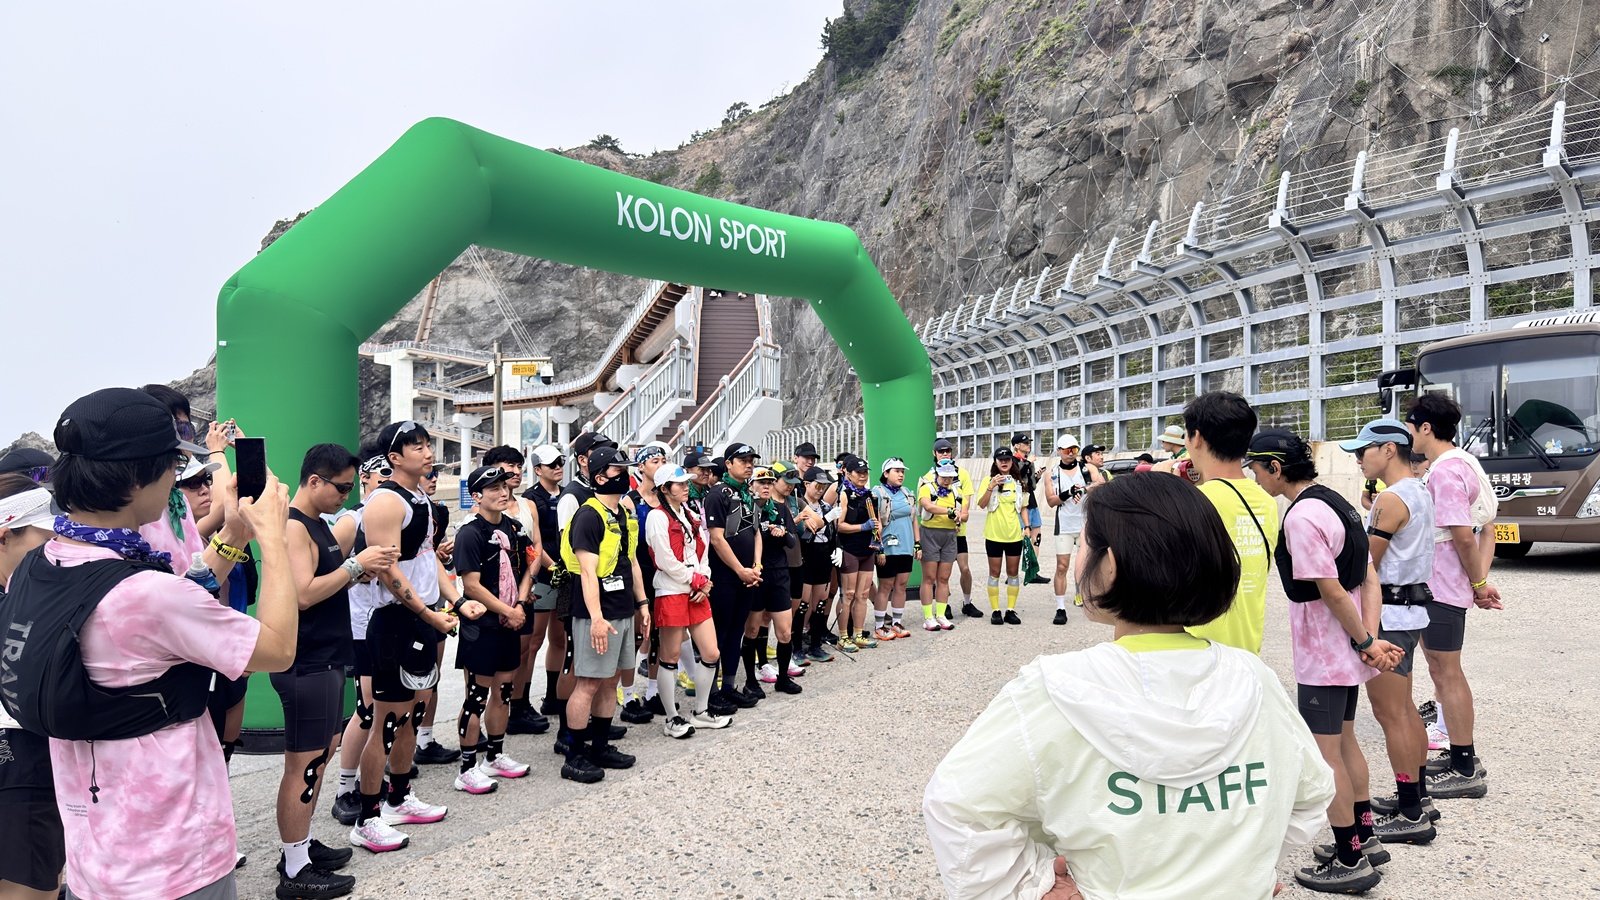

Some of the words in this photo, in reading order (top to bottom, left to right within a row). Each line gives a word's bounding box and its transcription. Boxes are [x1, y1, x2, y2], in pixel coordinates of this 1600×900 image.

[616, 191, 712, 245] KOLON
[719, 217, 787, 258] SPORT
[1536, 505, 1557, 516] 전세
[1236, 526, 1262, 536] TRAI
[1494, 531, 1516, 541] 531
[1235, 536, 1264, 546] CAMP
[284, 881, 306, 890] KOLON
